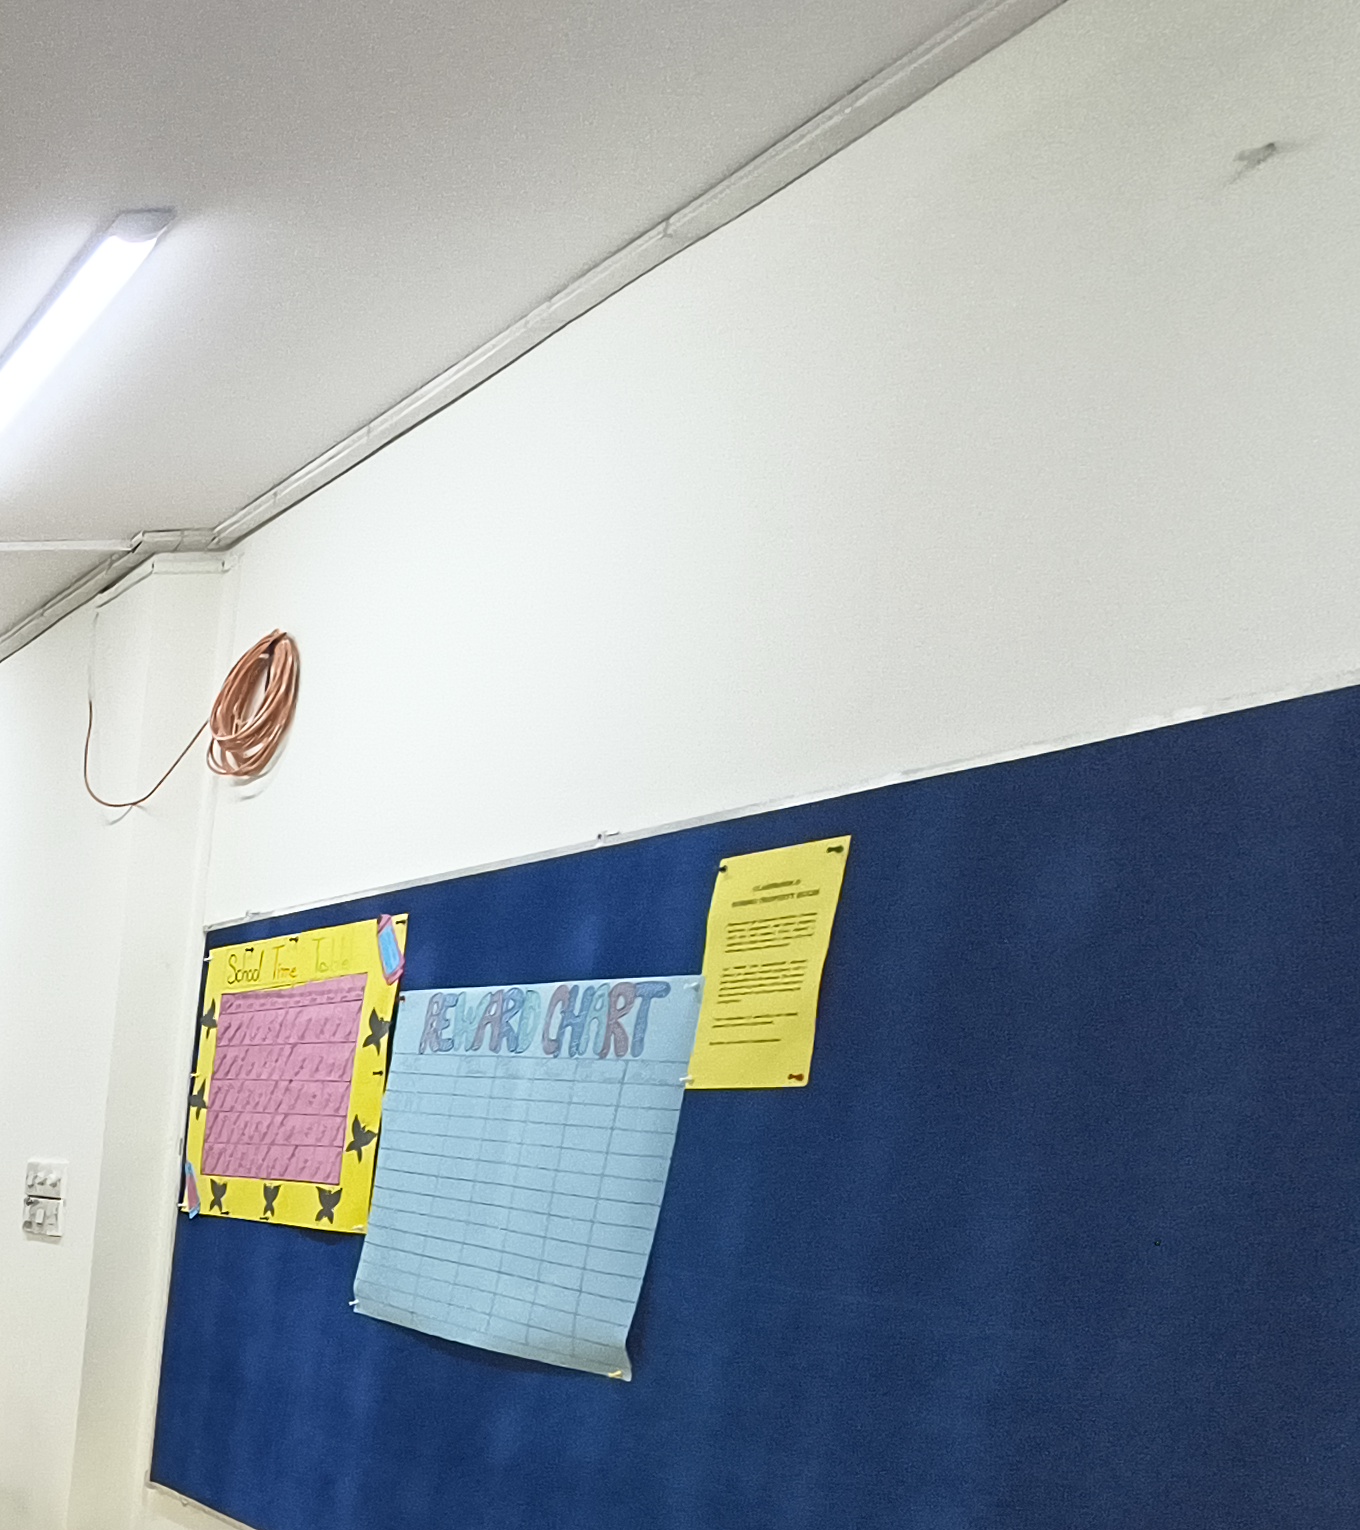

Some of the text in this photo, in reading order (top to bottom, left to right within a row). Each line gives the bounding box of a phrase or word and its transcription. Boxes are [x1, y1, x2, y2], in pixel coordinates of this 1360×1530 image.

[227, 950, 265, 984] School
[272, 944, 298, 981] Time
[419, 986, 541, 1055] REWARD
[542, 980, 672, 1059] CHART
